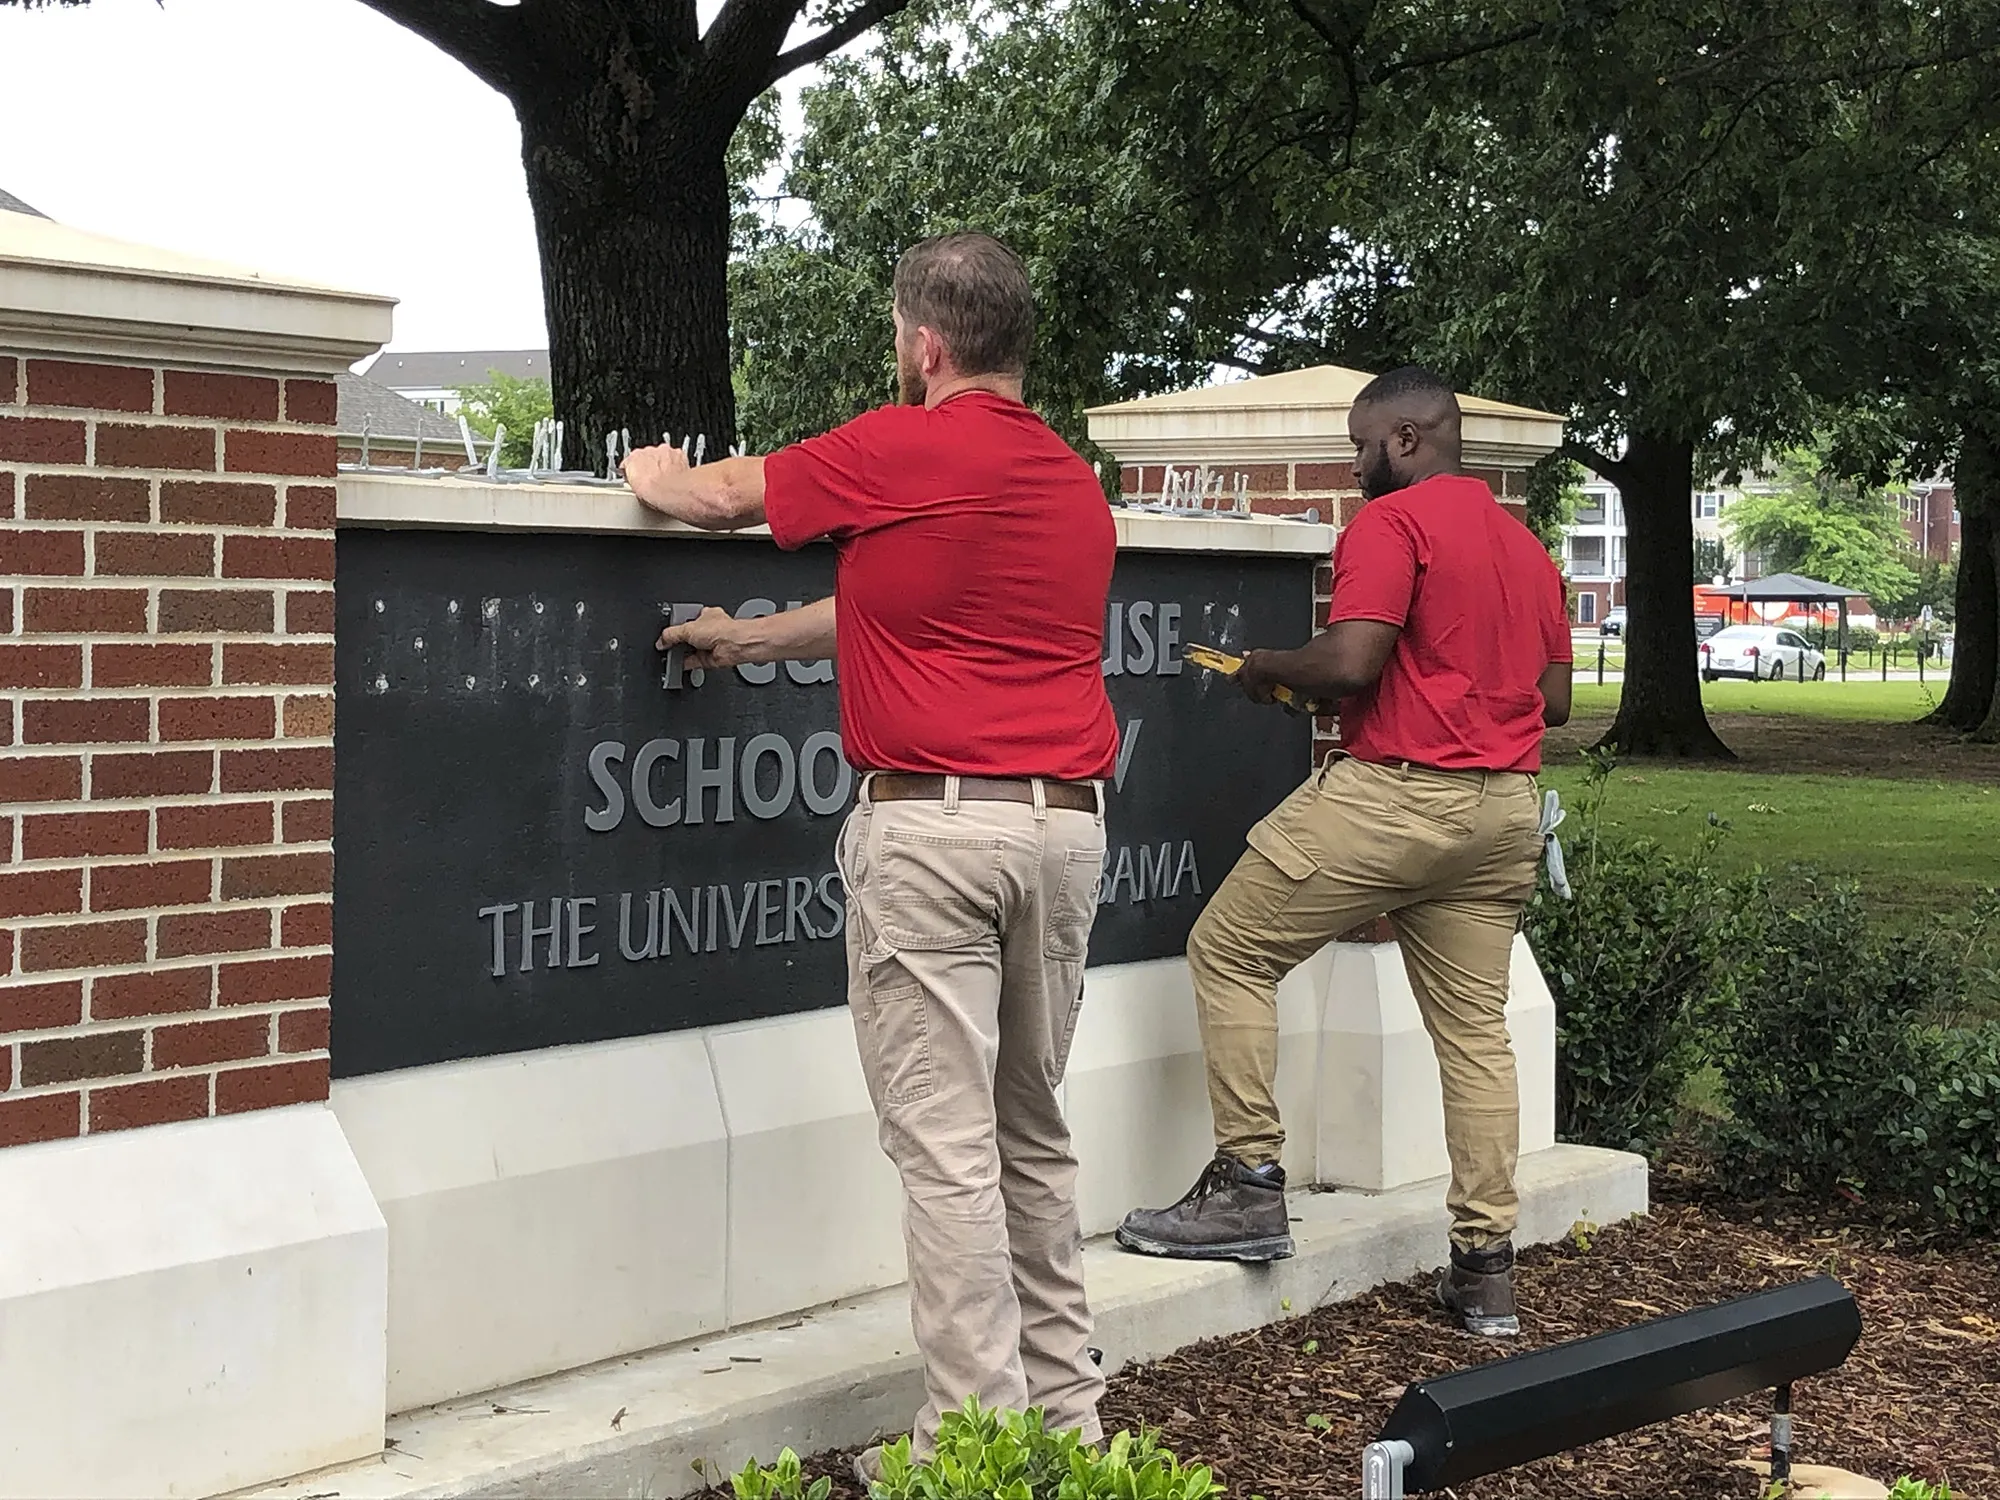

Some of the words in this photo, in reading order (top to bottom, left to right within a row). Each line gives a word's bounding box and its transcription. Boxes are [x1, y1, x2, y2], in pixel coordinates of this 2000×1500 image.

[584, 730, 852, 832] SCHOO
[478, 897, 600, 976] THE
[618, 872, 844, 961] UNIVERS
[1098, 840, 1202, 905] BAMA
